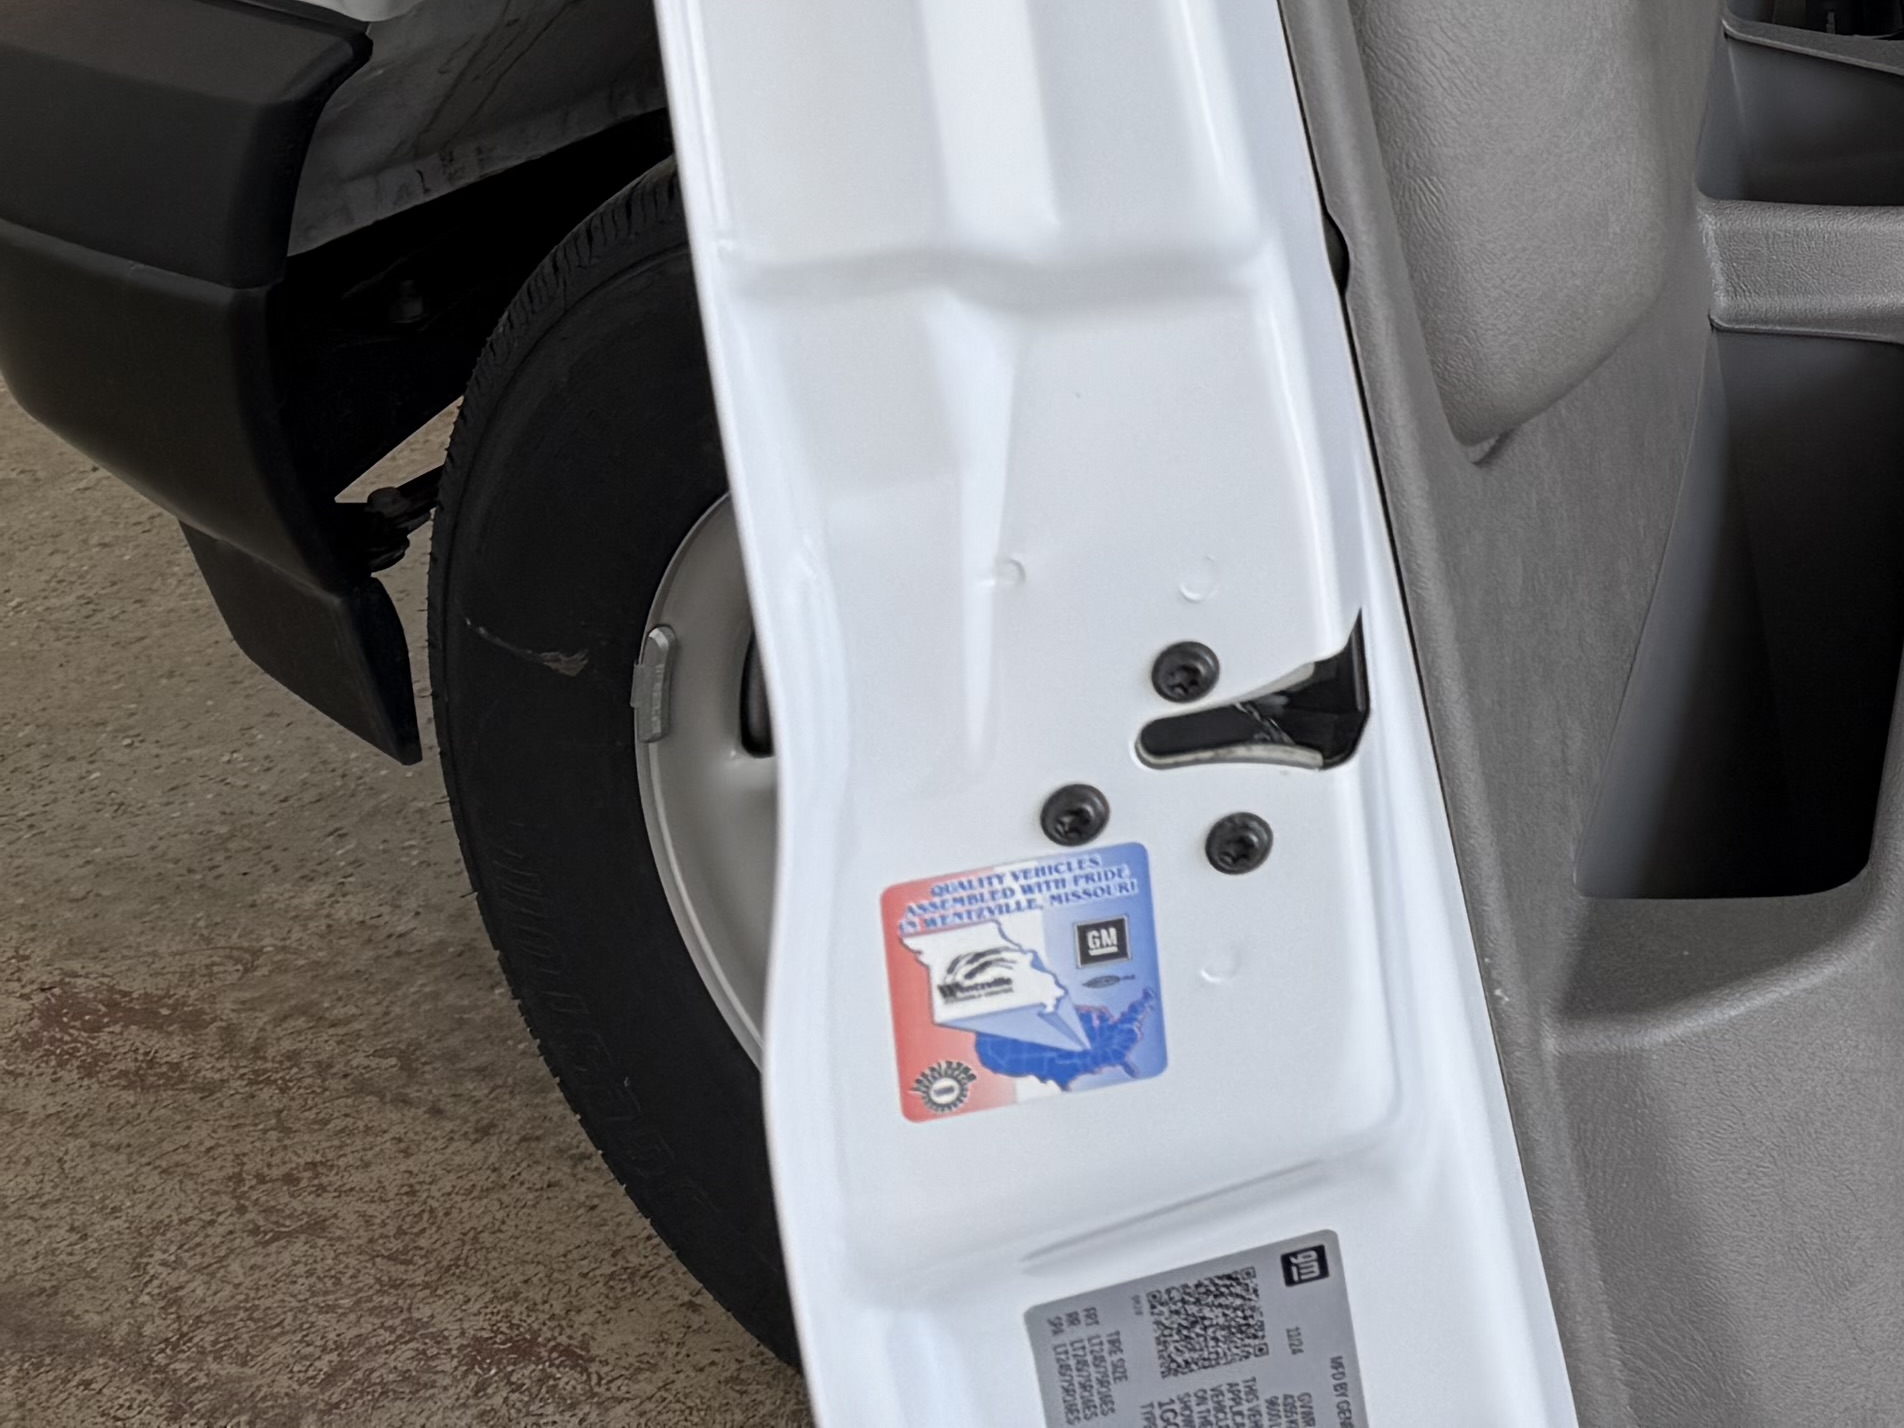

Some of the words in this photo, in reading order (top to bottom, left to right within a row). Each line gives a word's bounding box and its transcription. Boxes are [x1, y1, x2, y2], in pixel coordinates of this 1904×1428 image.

[906, 888, 1015, 917] ASSEMBLED
[1021, 878, 1066, 895] WITH
[1073, 867, 1129, 886] PRIDE
[931, 873, 1007, 895] QUALITY
[1012, 856, 1100, 882] VEHICLES
[900, 919, 918, 932] IN
[1049, 882, 1136, 906] MISSOURI
[1087, 927, 1118, 950] GM
[1290, 1250, 1320, 1280] gm
